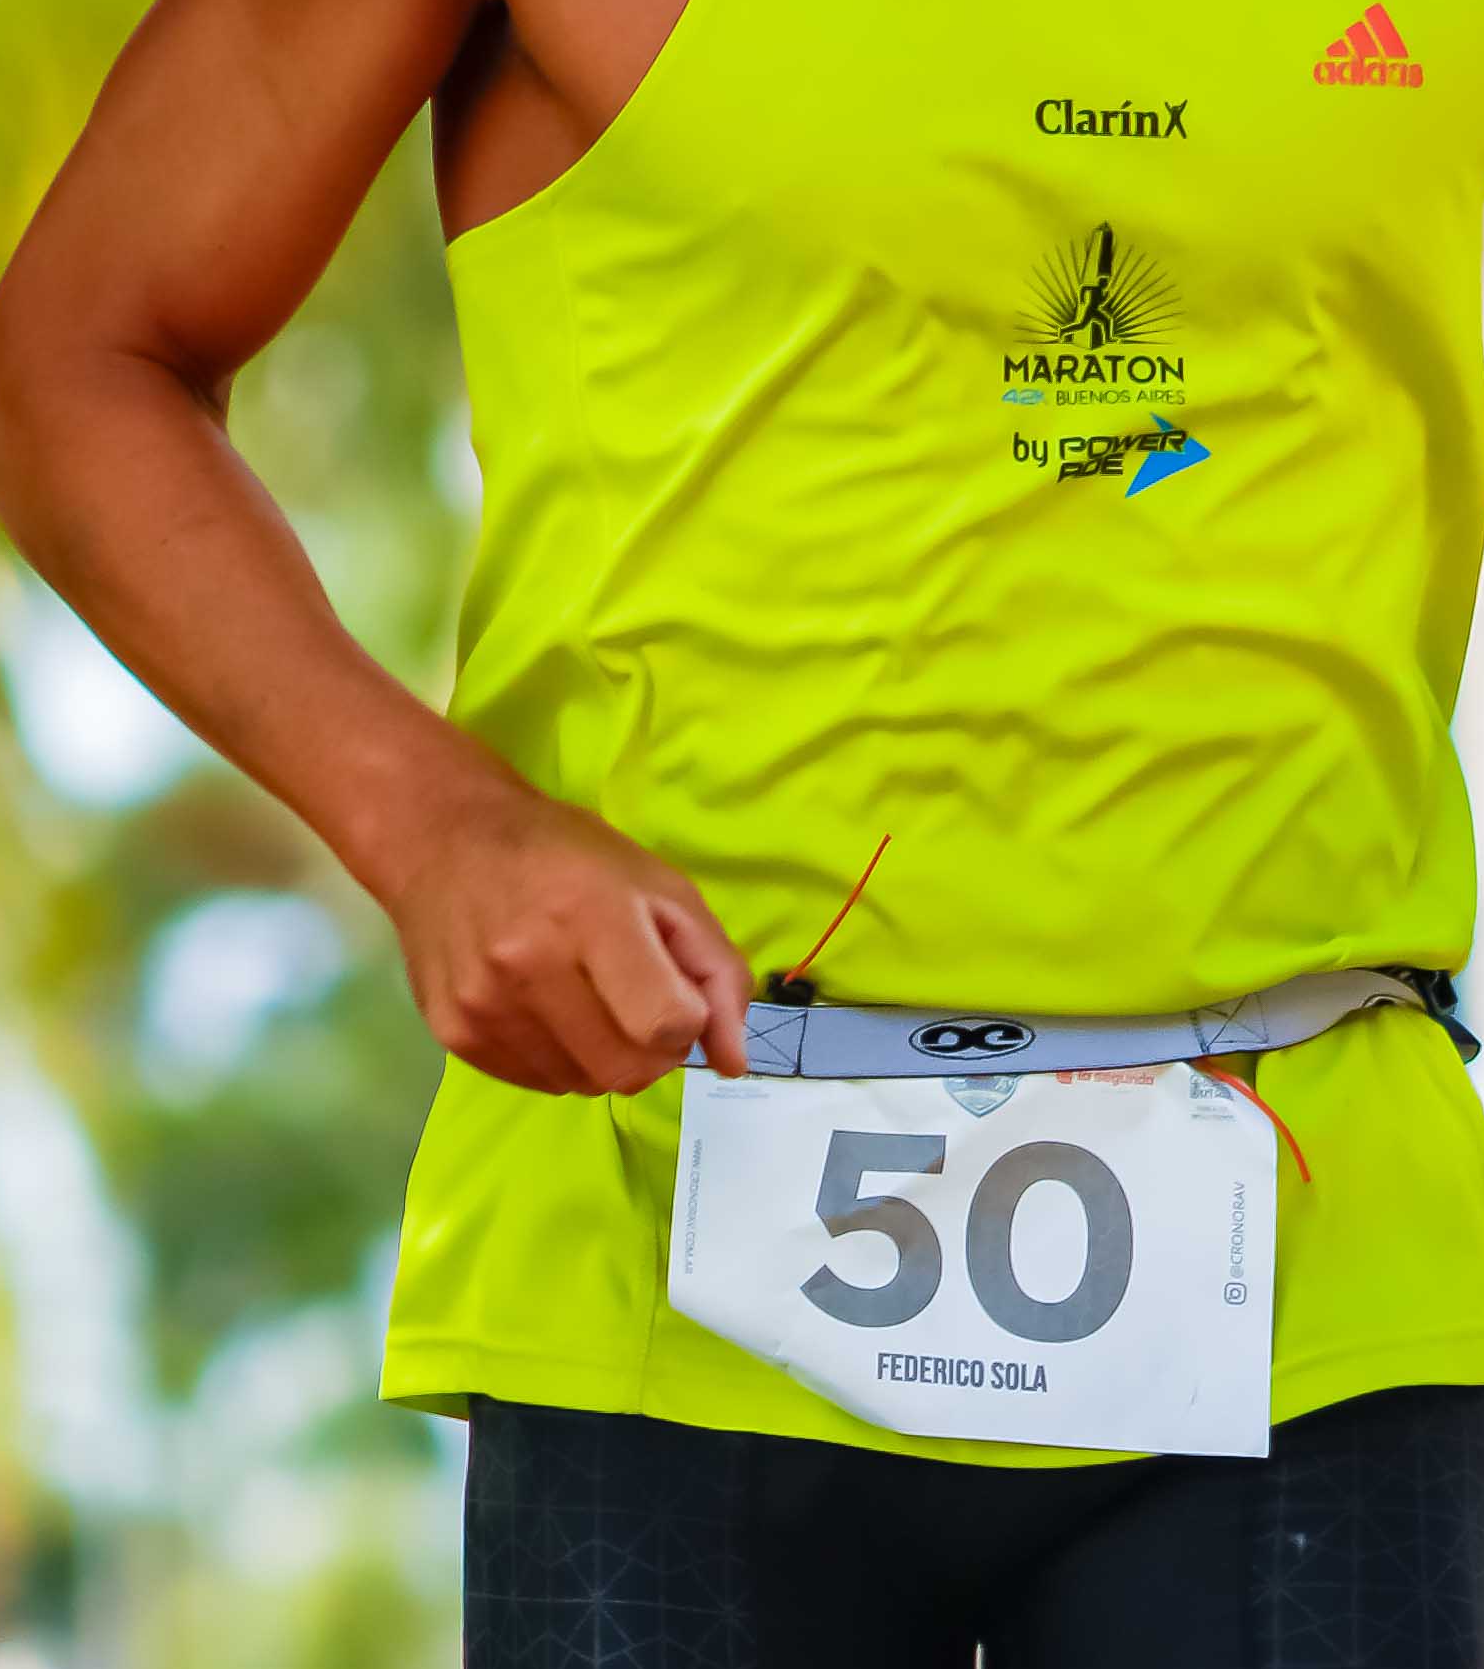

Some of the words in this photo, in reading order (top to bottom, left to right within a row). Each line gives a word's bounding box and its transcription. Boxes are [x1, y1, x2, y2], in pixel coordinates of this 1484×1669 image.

[1313, 59, 1423, 88] adidas
[1003, 354, 1184, 384] MARATON
[1055, 388, 1130, 406] BUENOS
[1136, 388, 1186, 405] AIRES
[1013, 431, 1048, 467] by
[1058, 430, 1188, 460] POWER
[800, 1129, 1133, 1343] 50
[1229, 1181, 1246, 1279] @CRONORAV
[877, 1352, 985, 1388] FEDERICO
[990, 1361, 1048, 1393] SOLA
